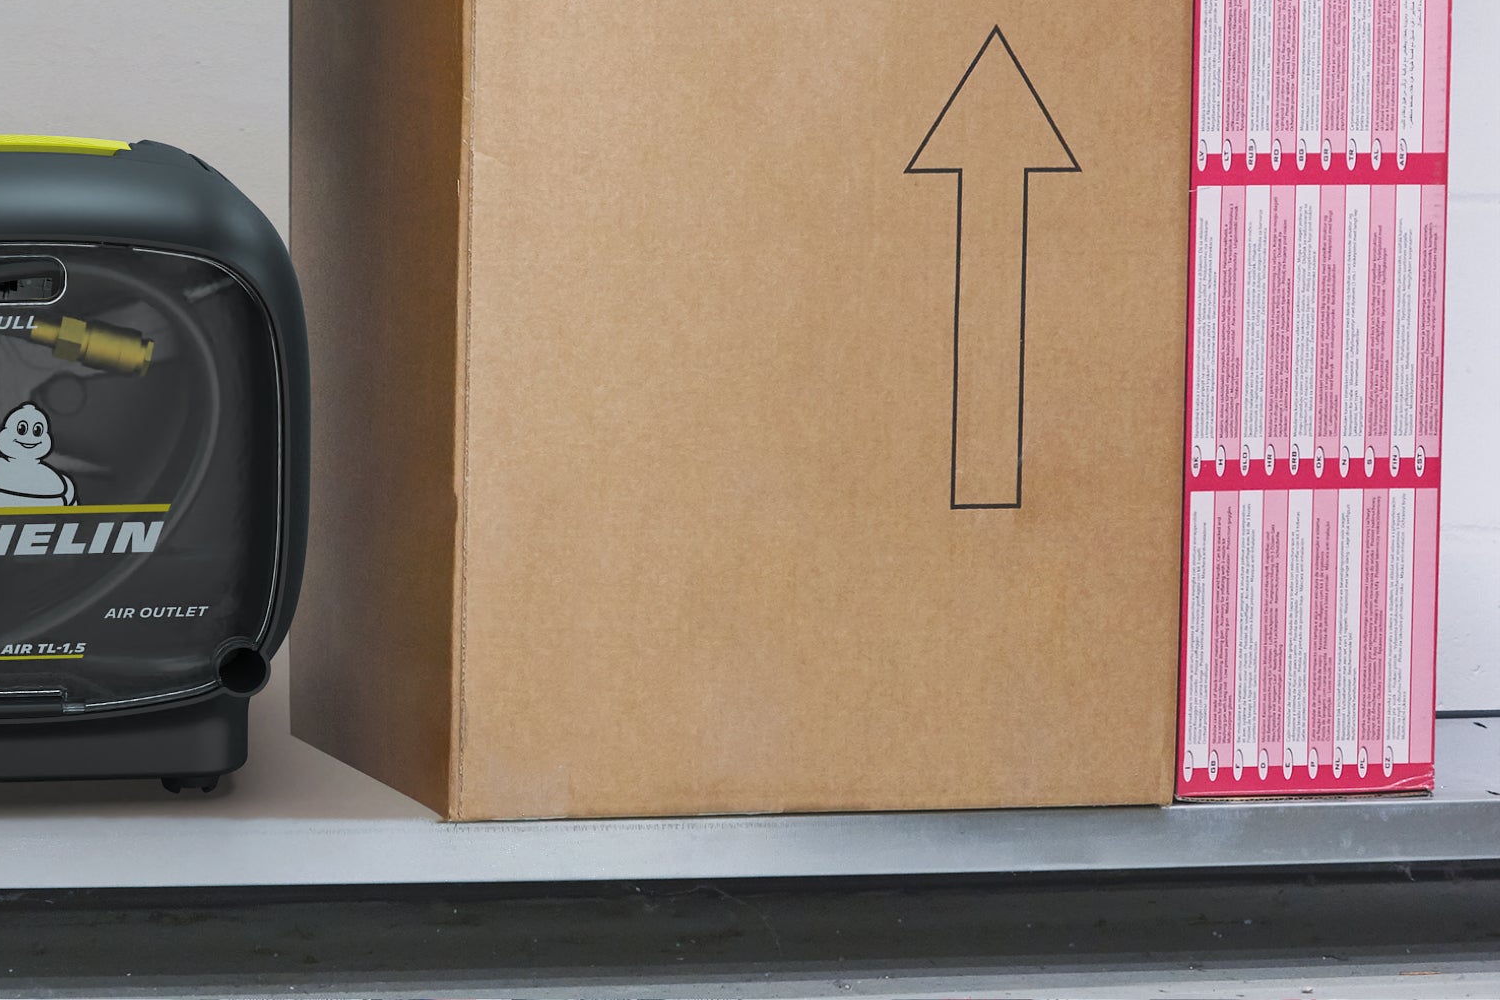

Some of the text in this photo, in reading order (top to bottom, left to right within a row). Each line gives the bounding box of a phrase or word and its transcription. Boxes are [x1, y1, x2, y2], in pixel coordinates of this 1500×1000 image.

[1199, 150, 1204, 162] LV
[1224, 150, 1229, 162] LT
[1348, 148, 1354, 161] TR
[1373, 148, 1379, 161] AL
[1398, 153, 1404, 167] AR
[1267, 454, 1272, 467] HR
[1316, 456, 1321, 468] DK
[104, 606, 209, 619] AIR OUTLET
[0, 643, 33, 655] AIR
[37, 642, 87, 655] TL-1,5
[1335, 757, 1340, 770] NL
[1360, 758, 1365, 769] PL
